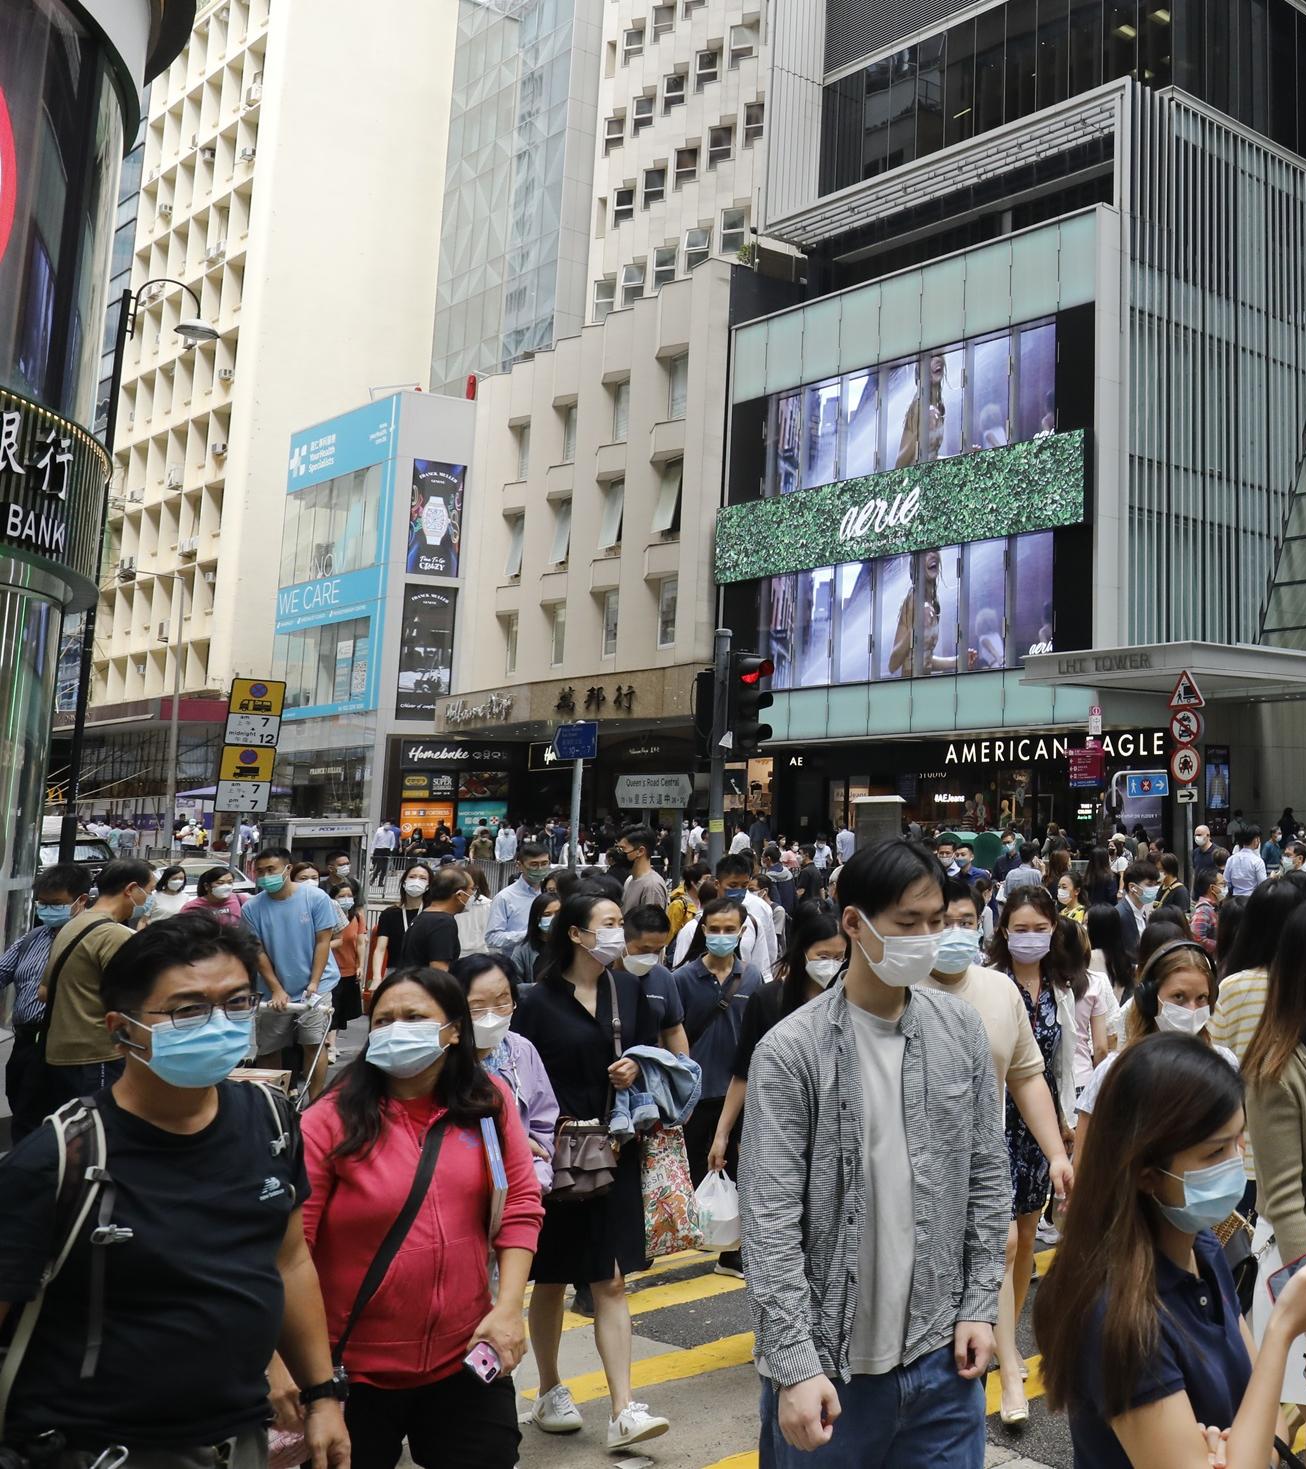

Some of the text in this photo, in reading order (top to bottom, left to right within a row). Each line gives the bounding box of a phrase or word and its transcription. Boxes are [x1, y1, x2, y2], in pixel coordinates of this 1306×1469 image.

[419, 471, 458, 484] FRANCK MULLER
[840, 478, 920, 544] aerie
[6, 503, 66, 553] BANK
[419, 563, 446, 571] CRAZY
[279, 579, 341, 615] WE CARE
[411, 593, 449, 604] FRANCK MULLER
[1057, 653, 1153, 675] LHT TOWER
[261, 717, 270, 727] 7
[259, 734, 275, 744] 12
[408, 746, 470, 761] Homebake
[945, 738, 1068, 764] AMERICAN
[789, 757, 803, 766] AE
[626, 777, 680, 788] Queen's Road Central
[251, 784, 260, 794] 7
[249, 800, 258, 810] 7
